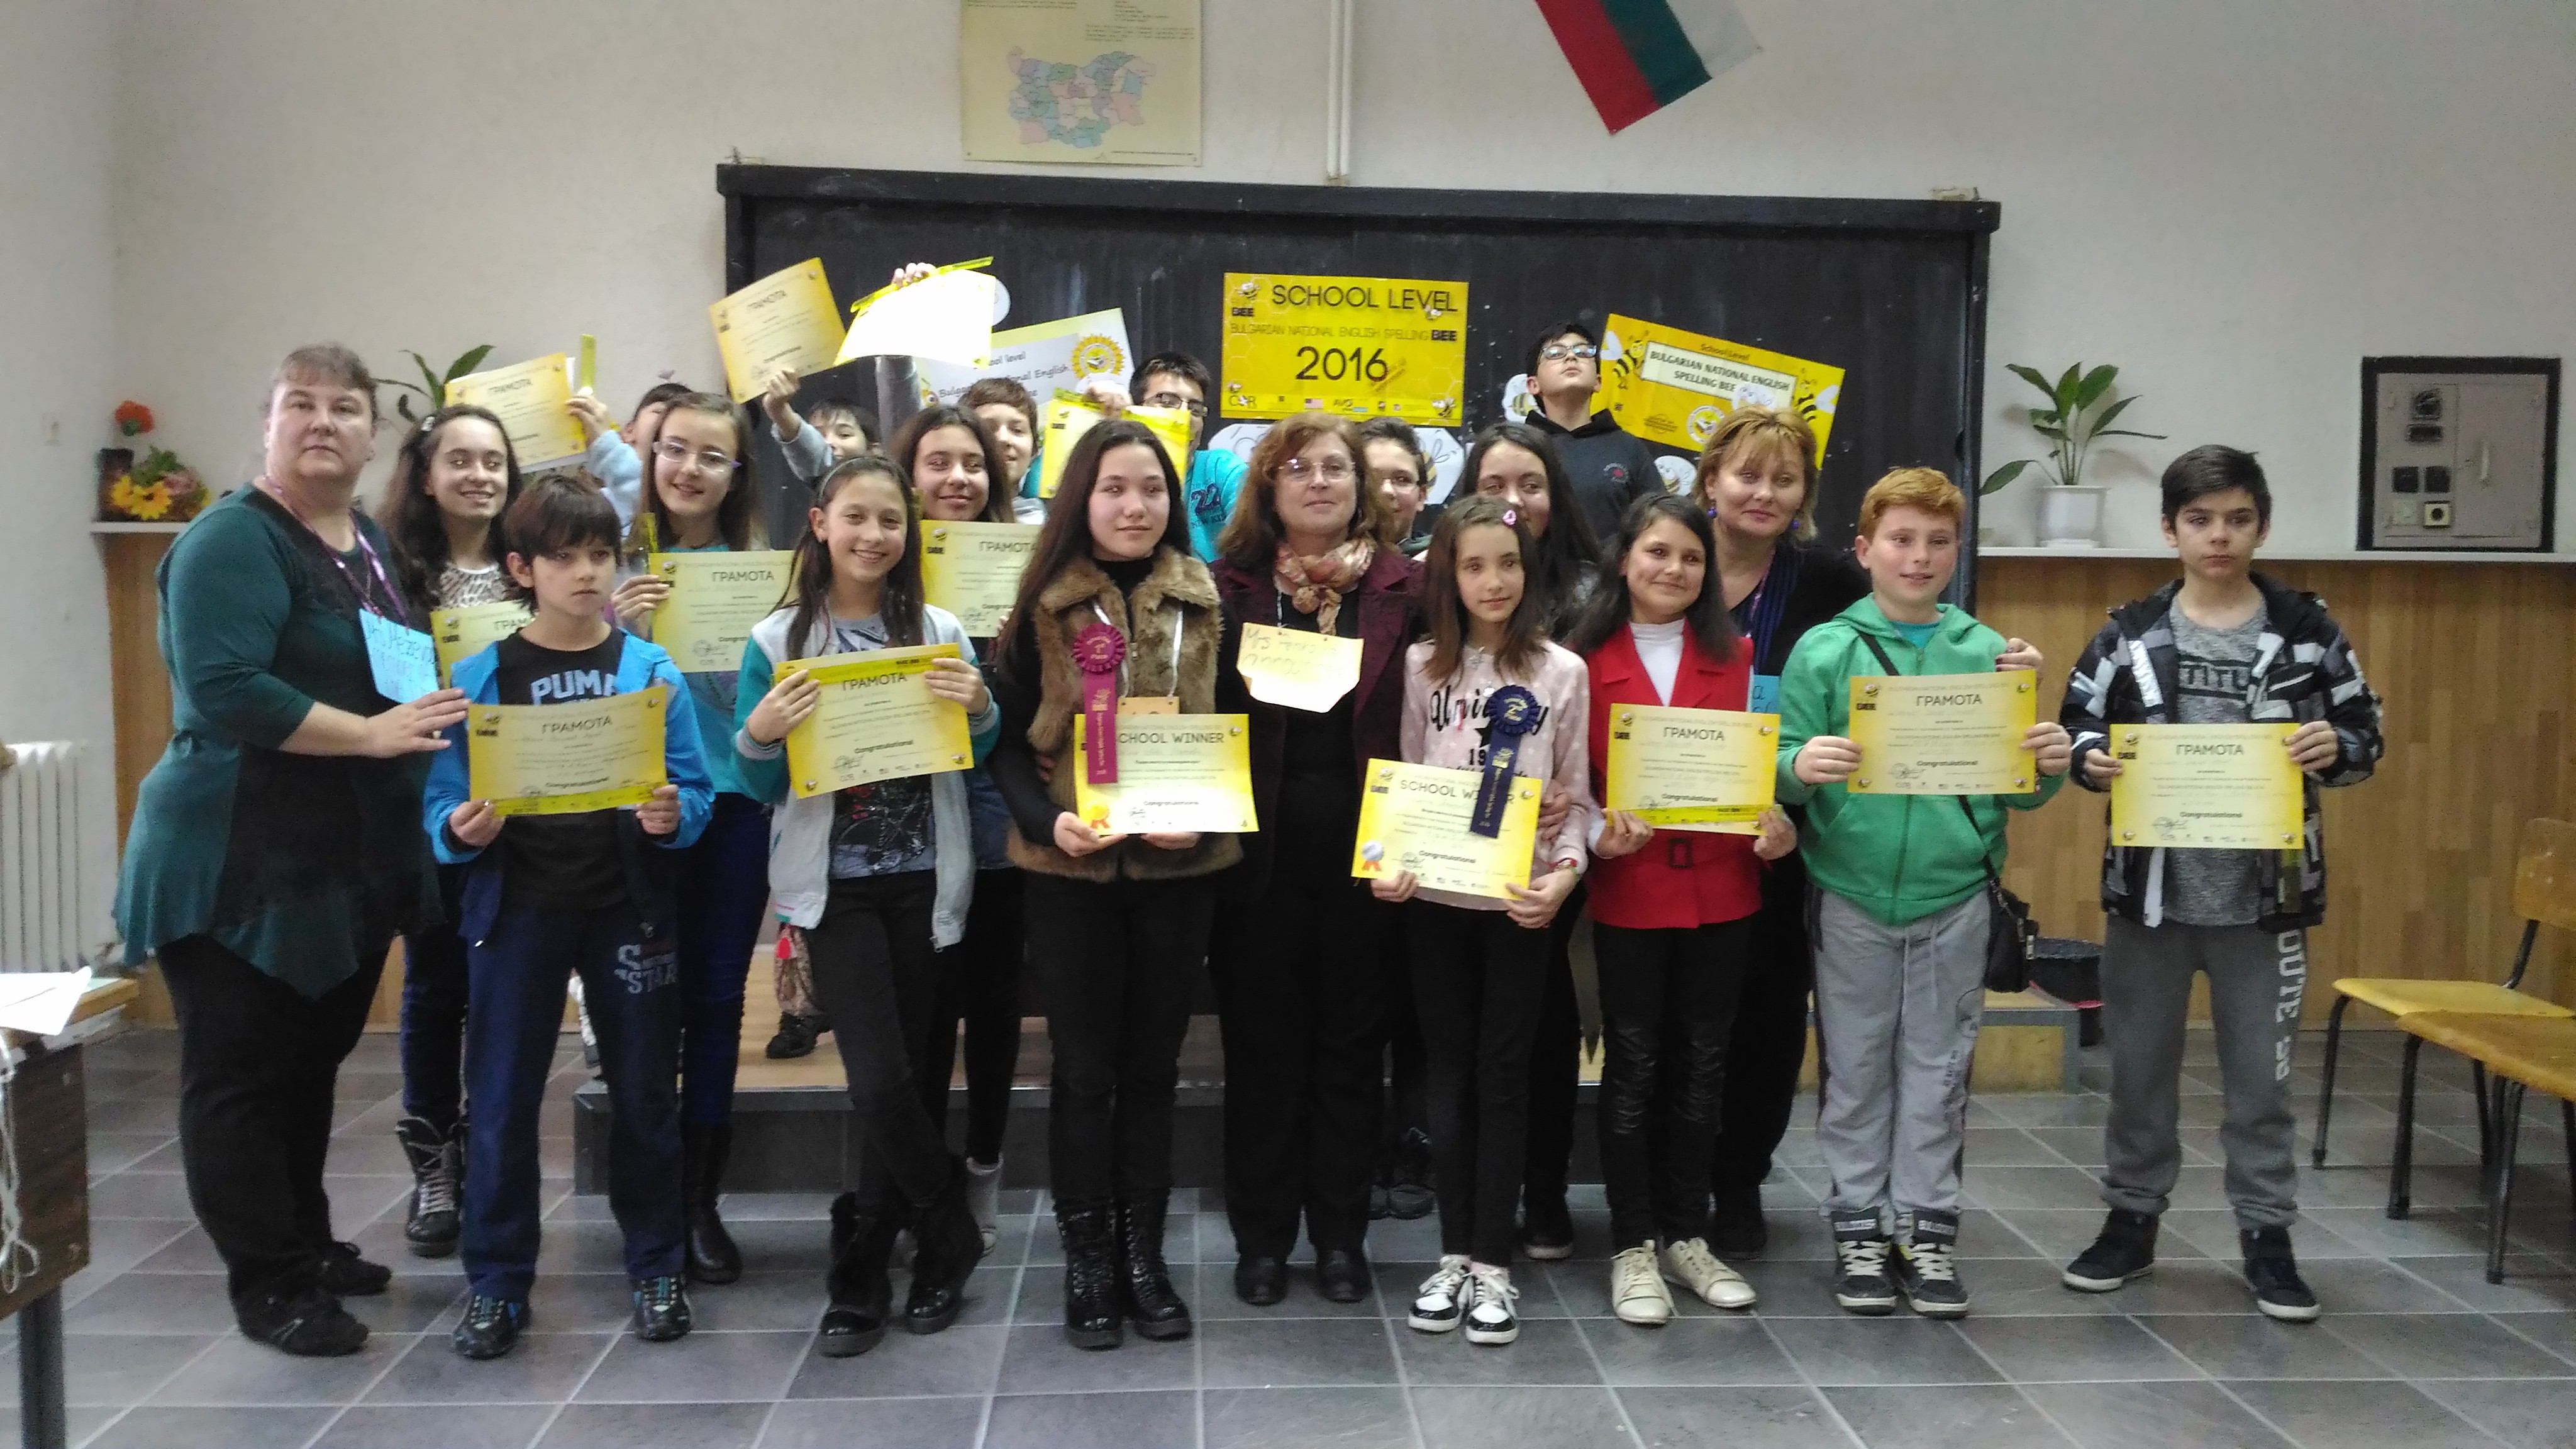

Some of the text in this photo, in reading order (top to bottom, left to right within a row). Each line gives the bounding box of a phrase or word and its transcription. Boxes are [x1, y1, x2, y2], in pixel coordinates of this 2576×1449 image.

[1272, 284, 1458, 313] SCHOOL LEVEL
[1231, 323, 1457, 341] BULGARIAN NATIONAL ENGLISH SPELLING BEE
[1296, 346, 1389, 381] 2016
[1650, 350, 1790, 391] BULGARIAN NATIONAL ENGLISH
[1674, 370, 1736, 392] SPELLING BEE
[1191, 482, 1221, 515] 22
[711, 570, 775, 582] ГРАМОТА
[842, 673, 908, 692] ГРАМОТА
[1916, 694, 1982, 707] ГРАМОТА
[542, 715, 613, 735] ГРАМОТА
[1663, 726, 1725, 741] ГРАМОТА
[1119, 732, 1224, 744] CHOOL WINNER
[2176, 744, 2244, 756] ГРАМОТА
[1400, 780, 1457, 797] SCHOOL
